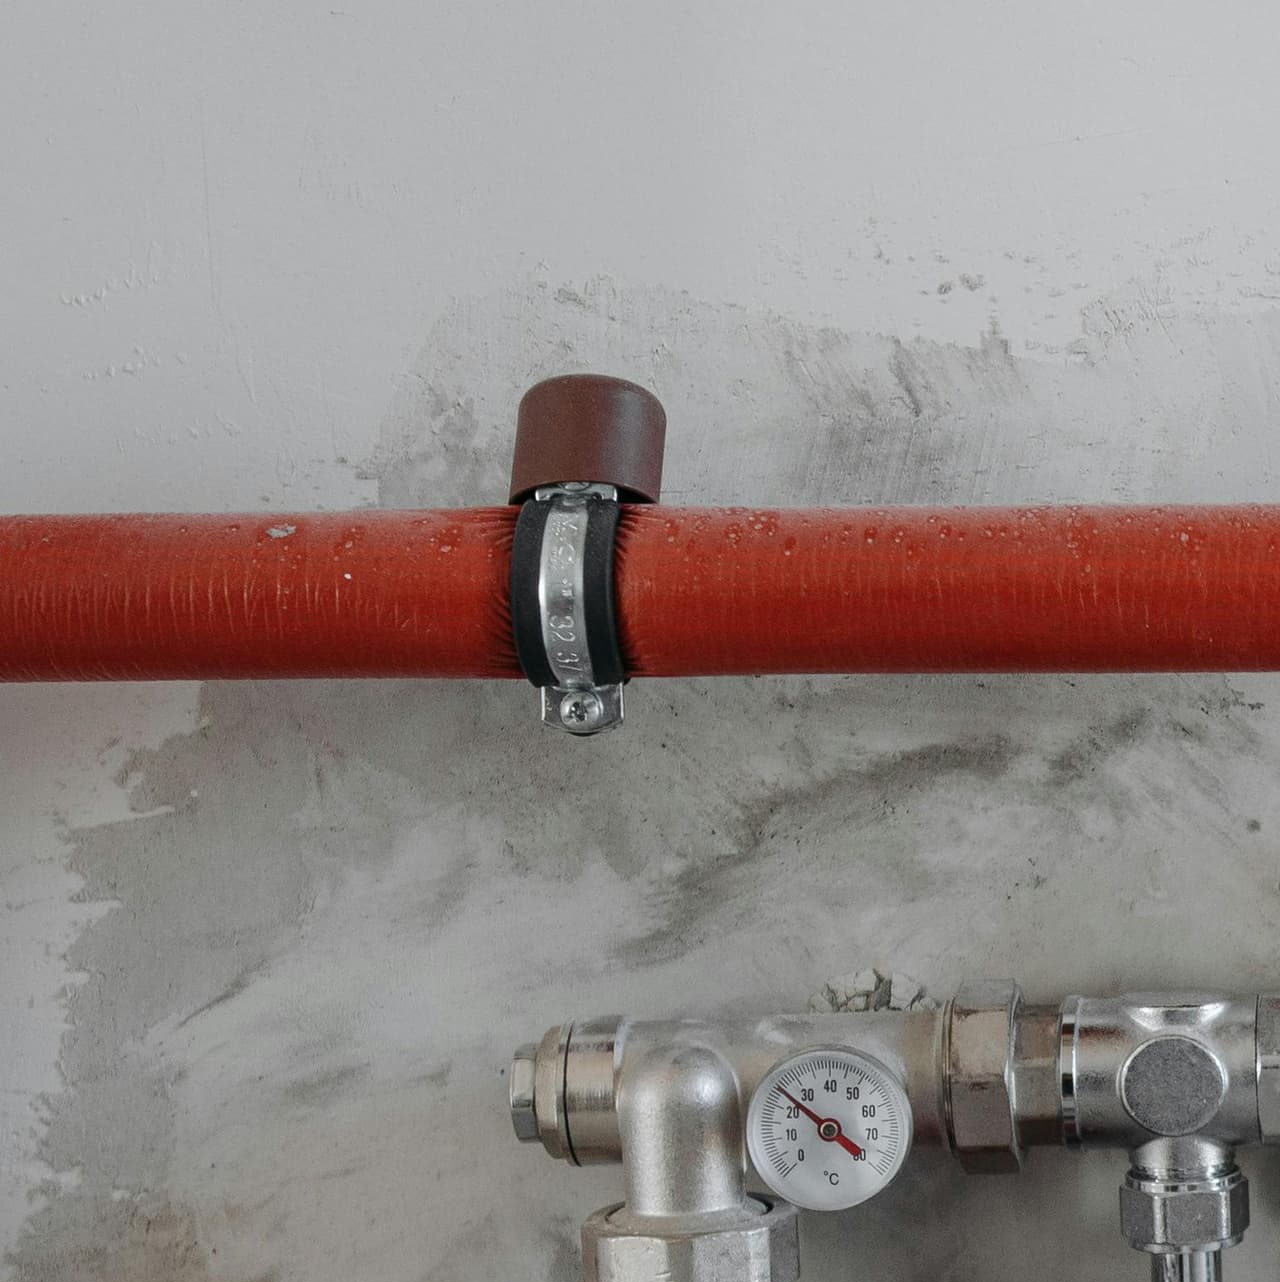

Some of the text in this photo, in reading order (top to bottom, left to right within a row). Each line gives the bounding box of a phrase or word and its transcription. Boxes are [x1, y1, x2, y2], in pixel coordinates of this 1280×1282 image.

[824, 1080, 837, 1092] 40
[801, 1089, 814, 1101] 30
[847, 1087, 859, 1100] 50
[787, 1106, 799, 1119] 20
[862, 1105, 875, 1118] 60
[786, 1129, 797, 1141] 10
[866, 1128, 878, 1140] 70
[798, 1149, 804, 1161] 0
[824, 1171, 839, 1185] °C
